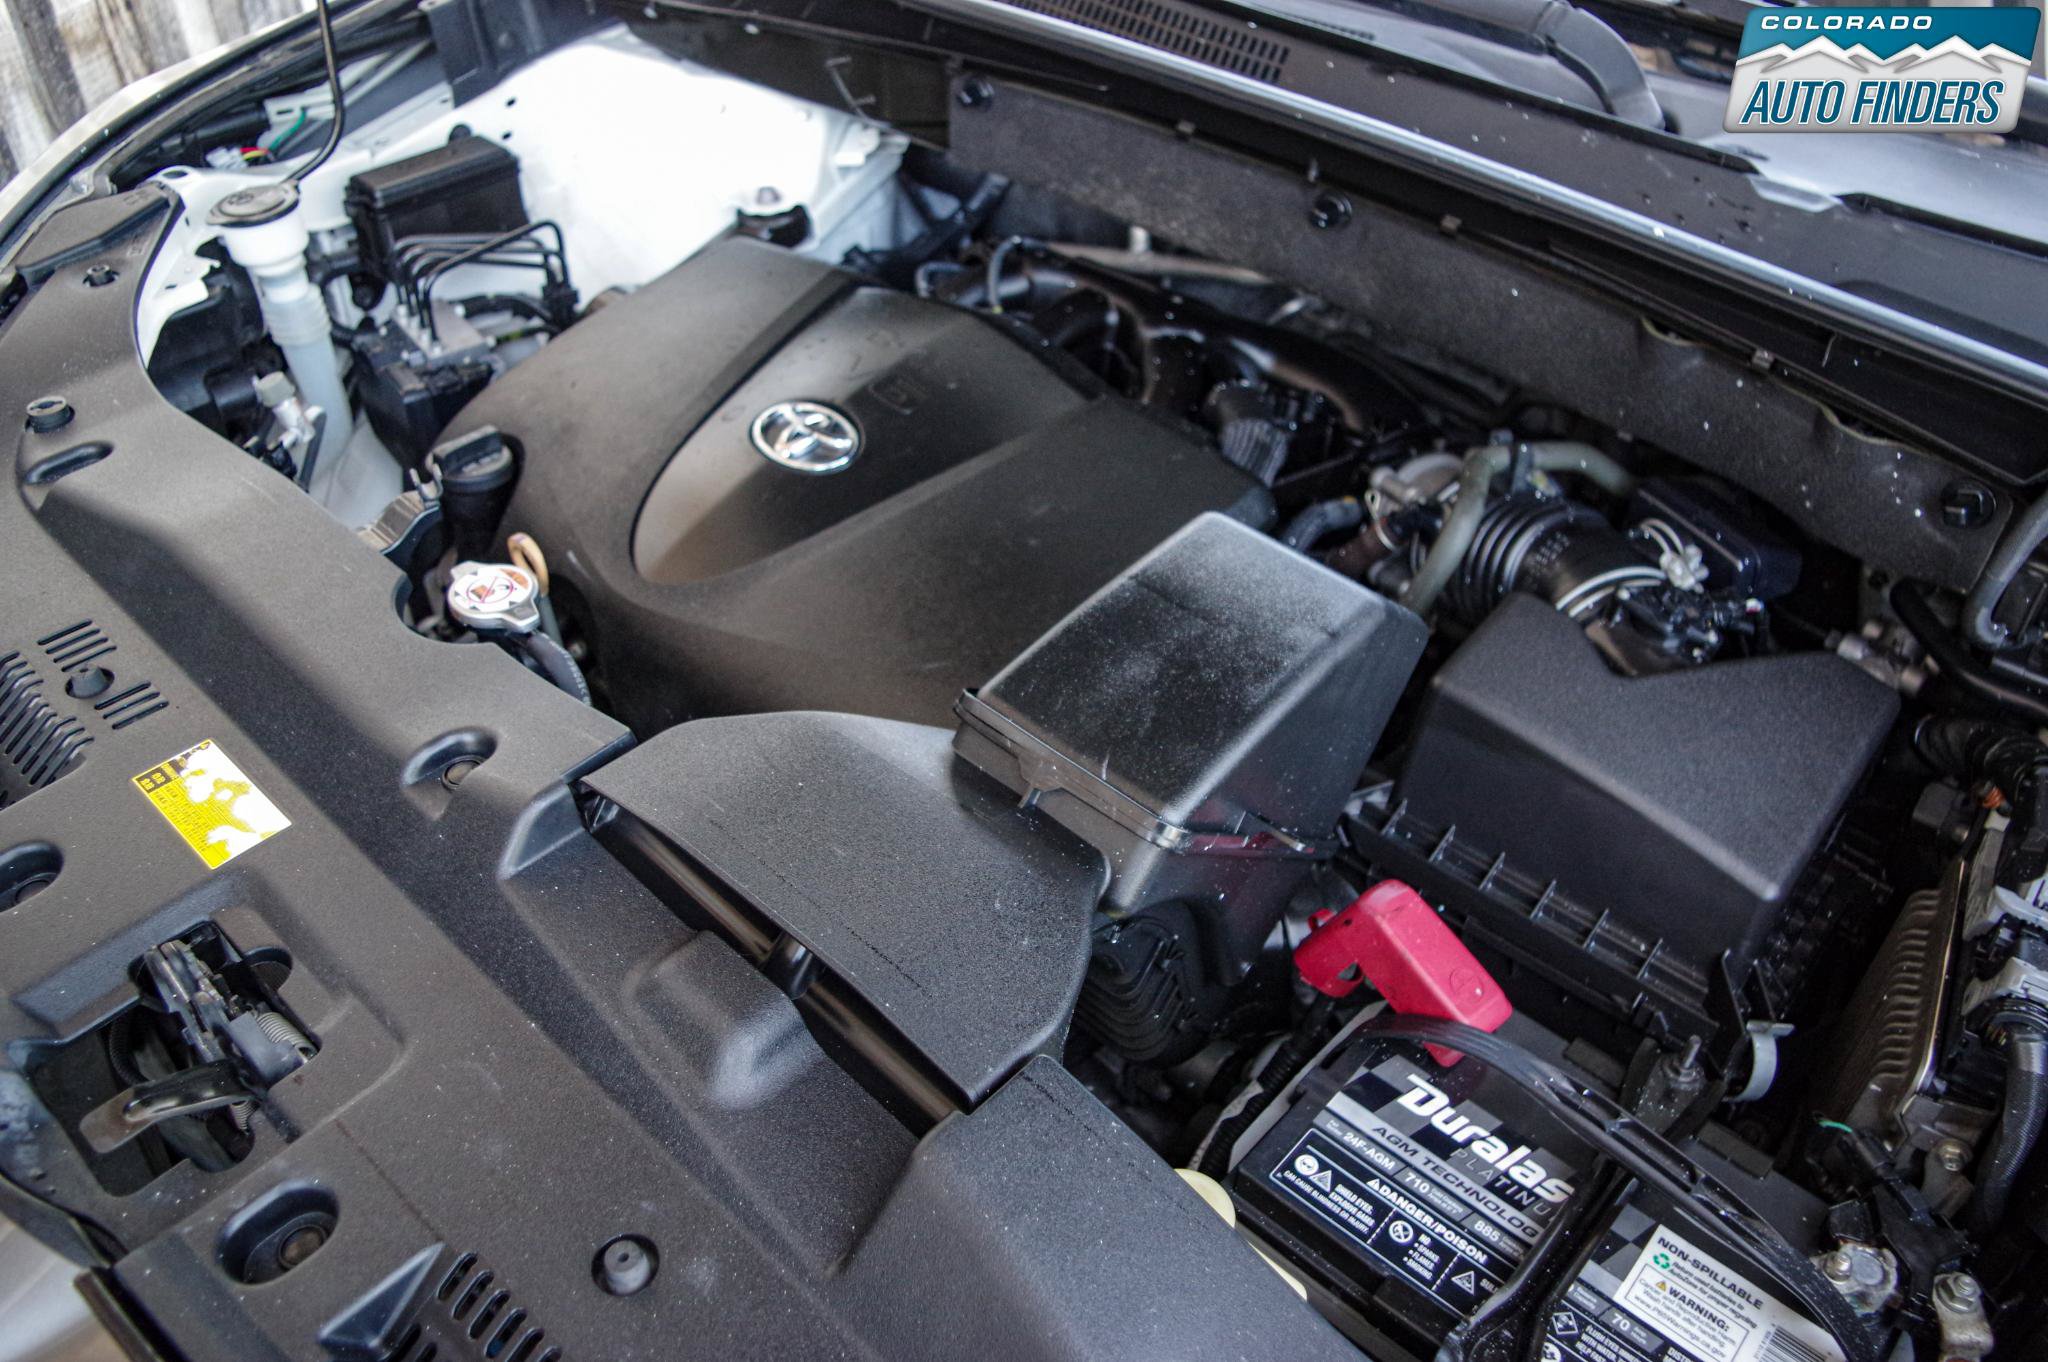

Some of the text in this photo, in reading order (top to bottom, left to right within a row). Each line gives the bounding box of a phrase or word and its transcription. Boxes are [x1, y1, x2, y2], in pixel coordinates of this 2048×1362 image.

[1343, 1132, 1396, 1170] 24F-AGM
[1396, 1073, 1576, 1205] Duralas
[1283, 1169, 1298, 1182] CAN
[1294, 1177, 1314, 1194] CAUSE
[1311, 1187, 1342, 1214] BLINDNESS
[1339, 1209, 1350, 1220] OR
[1334, 1183, 1358, 1204] SHIELD
[1372, 1126, 1540, 1240] AGM TECHNOLOG
[1404, 1172, 1430, 1194] 710
[1451, 1147, 1557, 1222] PLATINU
[1328, 1191, 1358, 1215] EXPLOSIVE
[1379, 1184, 1488, 1263] DANGER/POISON
[1418, 1233, 1432, 1246] NO
[1474, 1219, 1501, 1242] 885
[1411, 1251, 1436, 1270] FLAMES
[1657, 1236, 1764, 1310] NON-SPILLABLE
[1639, 1279, 1662, 1295] Cancer
[1662, 1293, 1676, 1304] and
[1676, 1301, 1717, 1331] Reproductive
[1643, 1290, 1662, 1304] Wash
[1662, 1301, 1681, 1317] hands
[1669, 1268, 1757, 1329] AutoZone for proper recycling
[1672, 1261, 1745, 1311] Return used batteries to
[1610, 1312, 1631, 1331] 70
[1669, 1286, 1730, 1332] WARNING:
[1581, 1332, 1598, 1348] WITH
[1585, 1324, 1606, 1341] FLUSH
